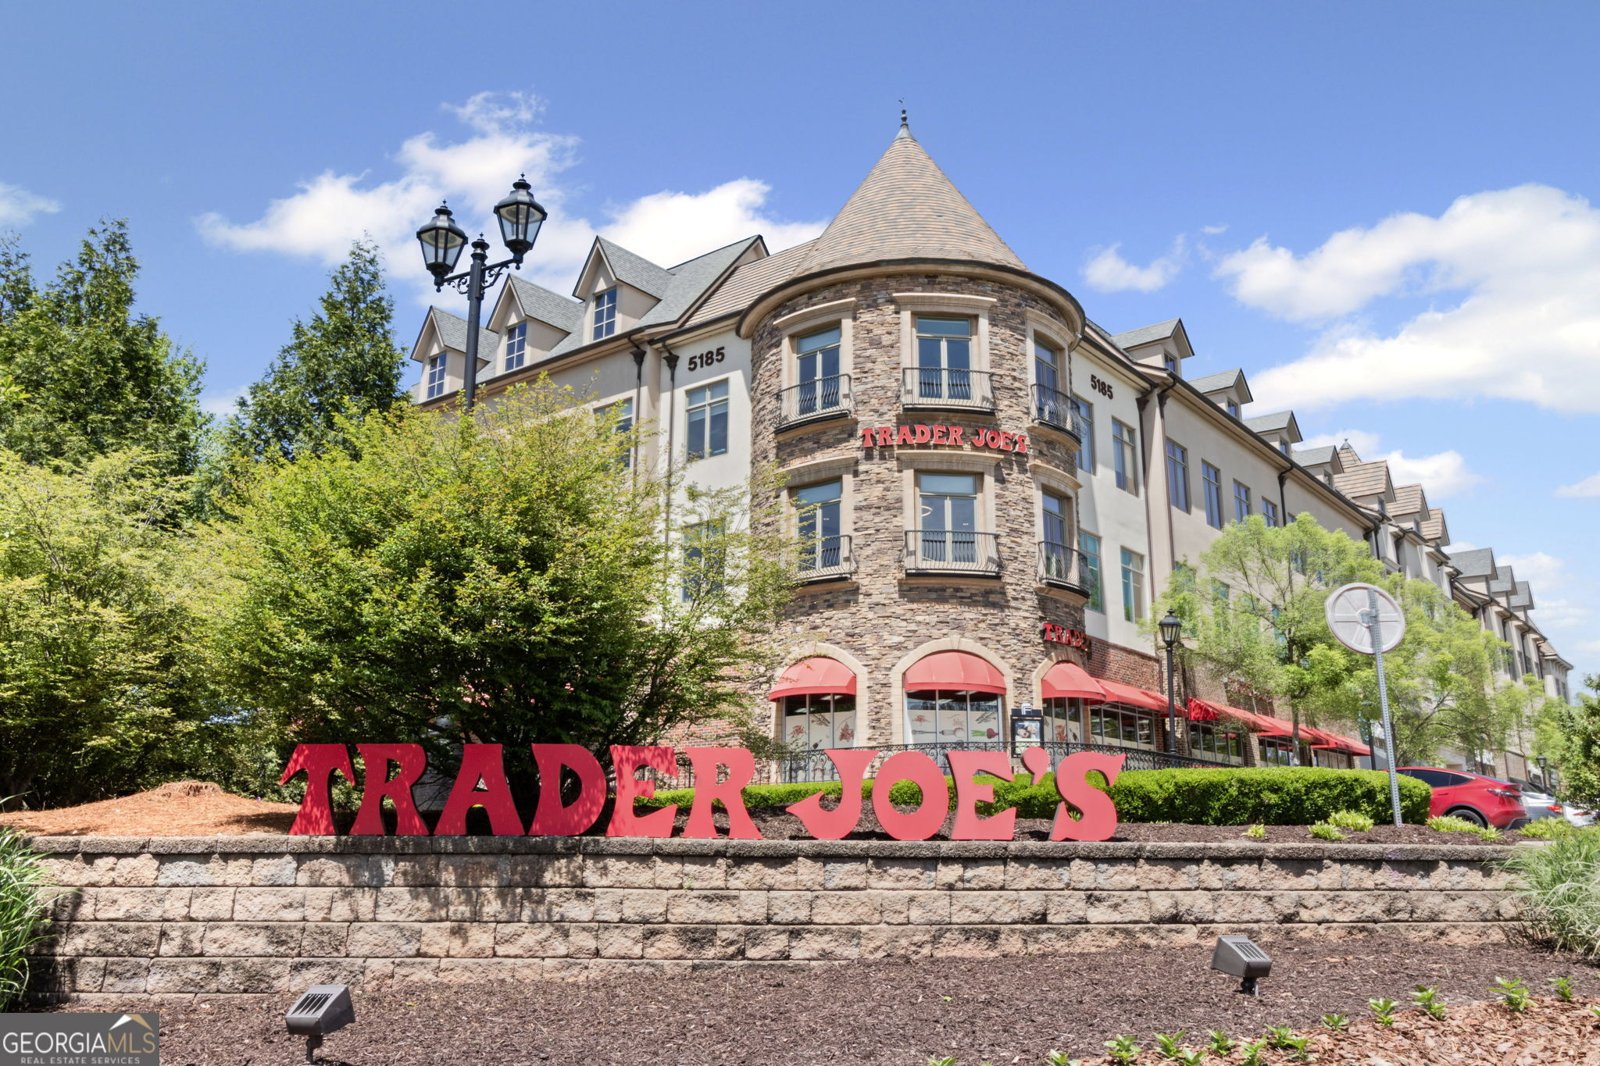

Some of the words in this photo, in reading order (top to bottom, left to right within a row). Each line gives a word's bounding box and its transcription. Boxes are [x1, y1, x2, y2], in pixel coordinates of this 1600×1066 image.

[688, 346, 725, 372] 5185
[1090, 374, 1113, 400] 5185
[862, 424, 964, 448] TRADER
[971, 427, 1028, 453] JOE'S
[279, 743, 763, 840] TRADER
[785, 746, 1127, 841] JOE'S
